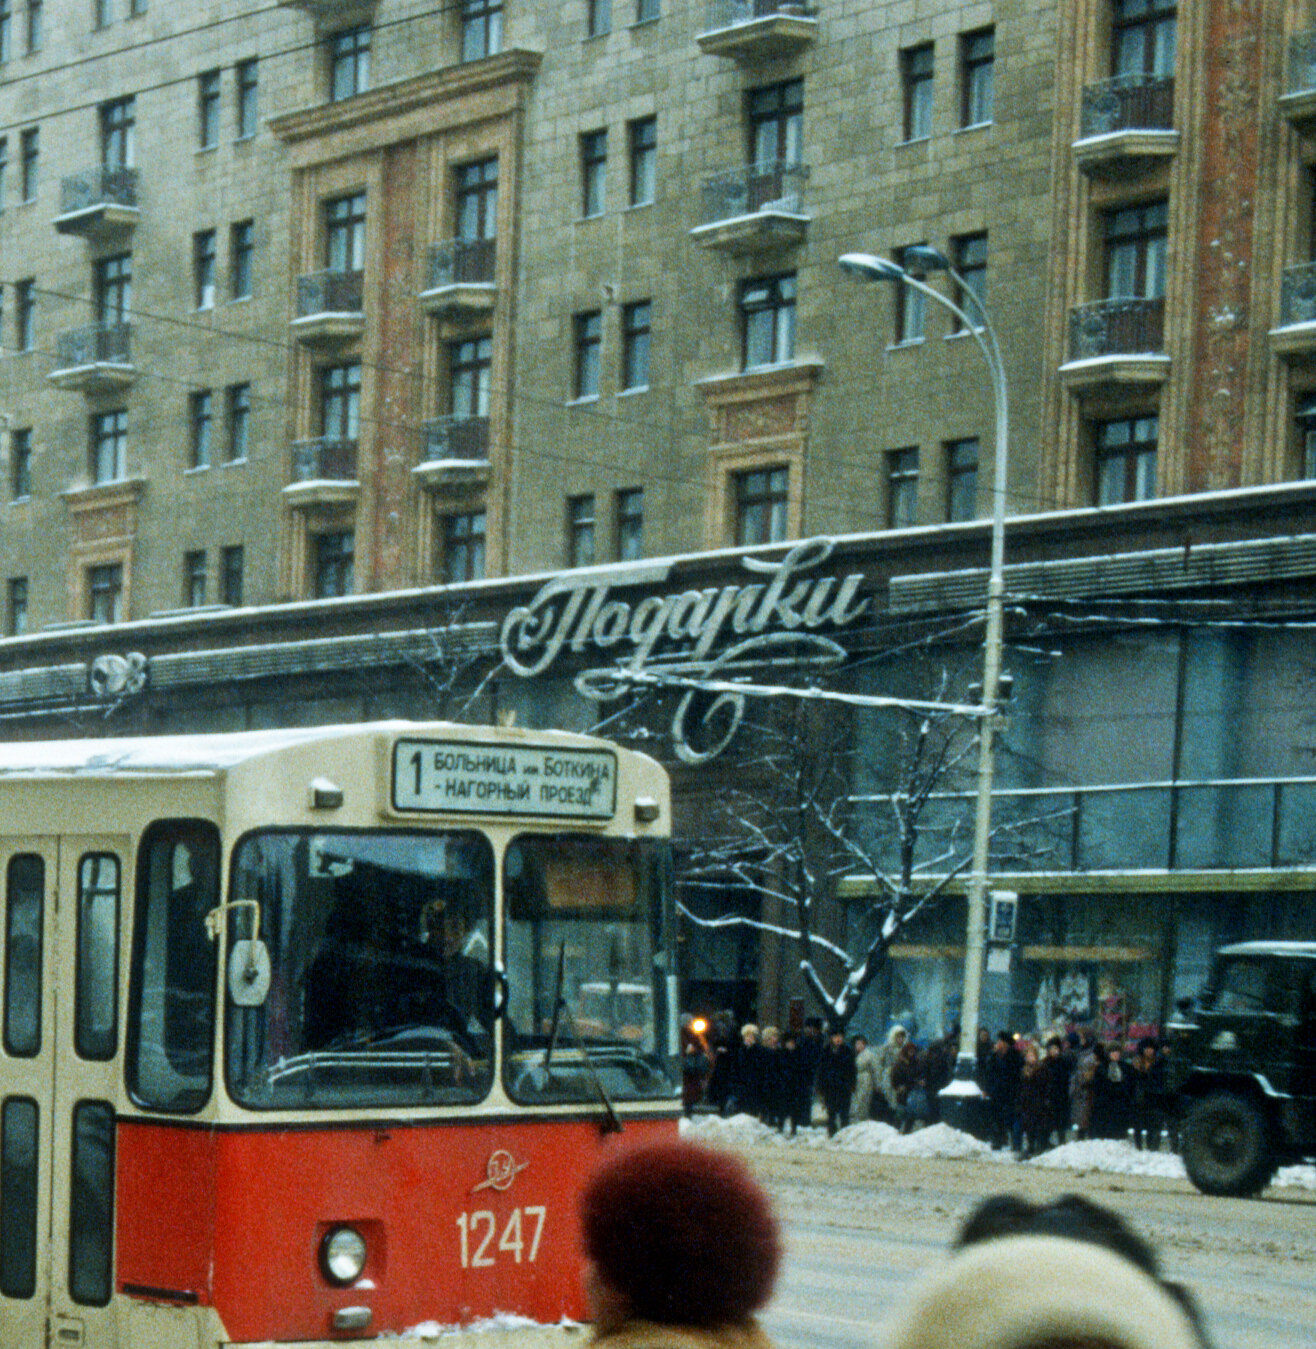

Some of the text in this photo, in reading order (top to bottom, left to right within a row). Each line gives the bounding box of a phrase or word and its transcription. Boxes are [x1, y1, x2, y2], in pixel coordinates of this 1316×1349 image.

[499, 535, 871, 764] Подарки
[410, 750, 422, 795] 1
[433, 751, 516, 775] БОЛЬНИЦА
[543, 756, 609, 780] БОТКИНА
[445, 777, 531, 801] НАГОРНЫЙ
[540, 783, 592, 806] ПРОЕЗД
[455, 1205, 546, 1268] 1247
